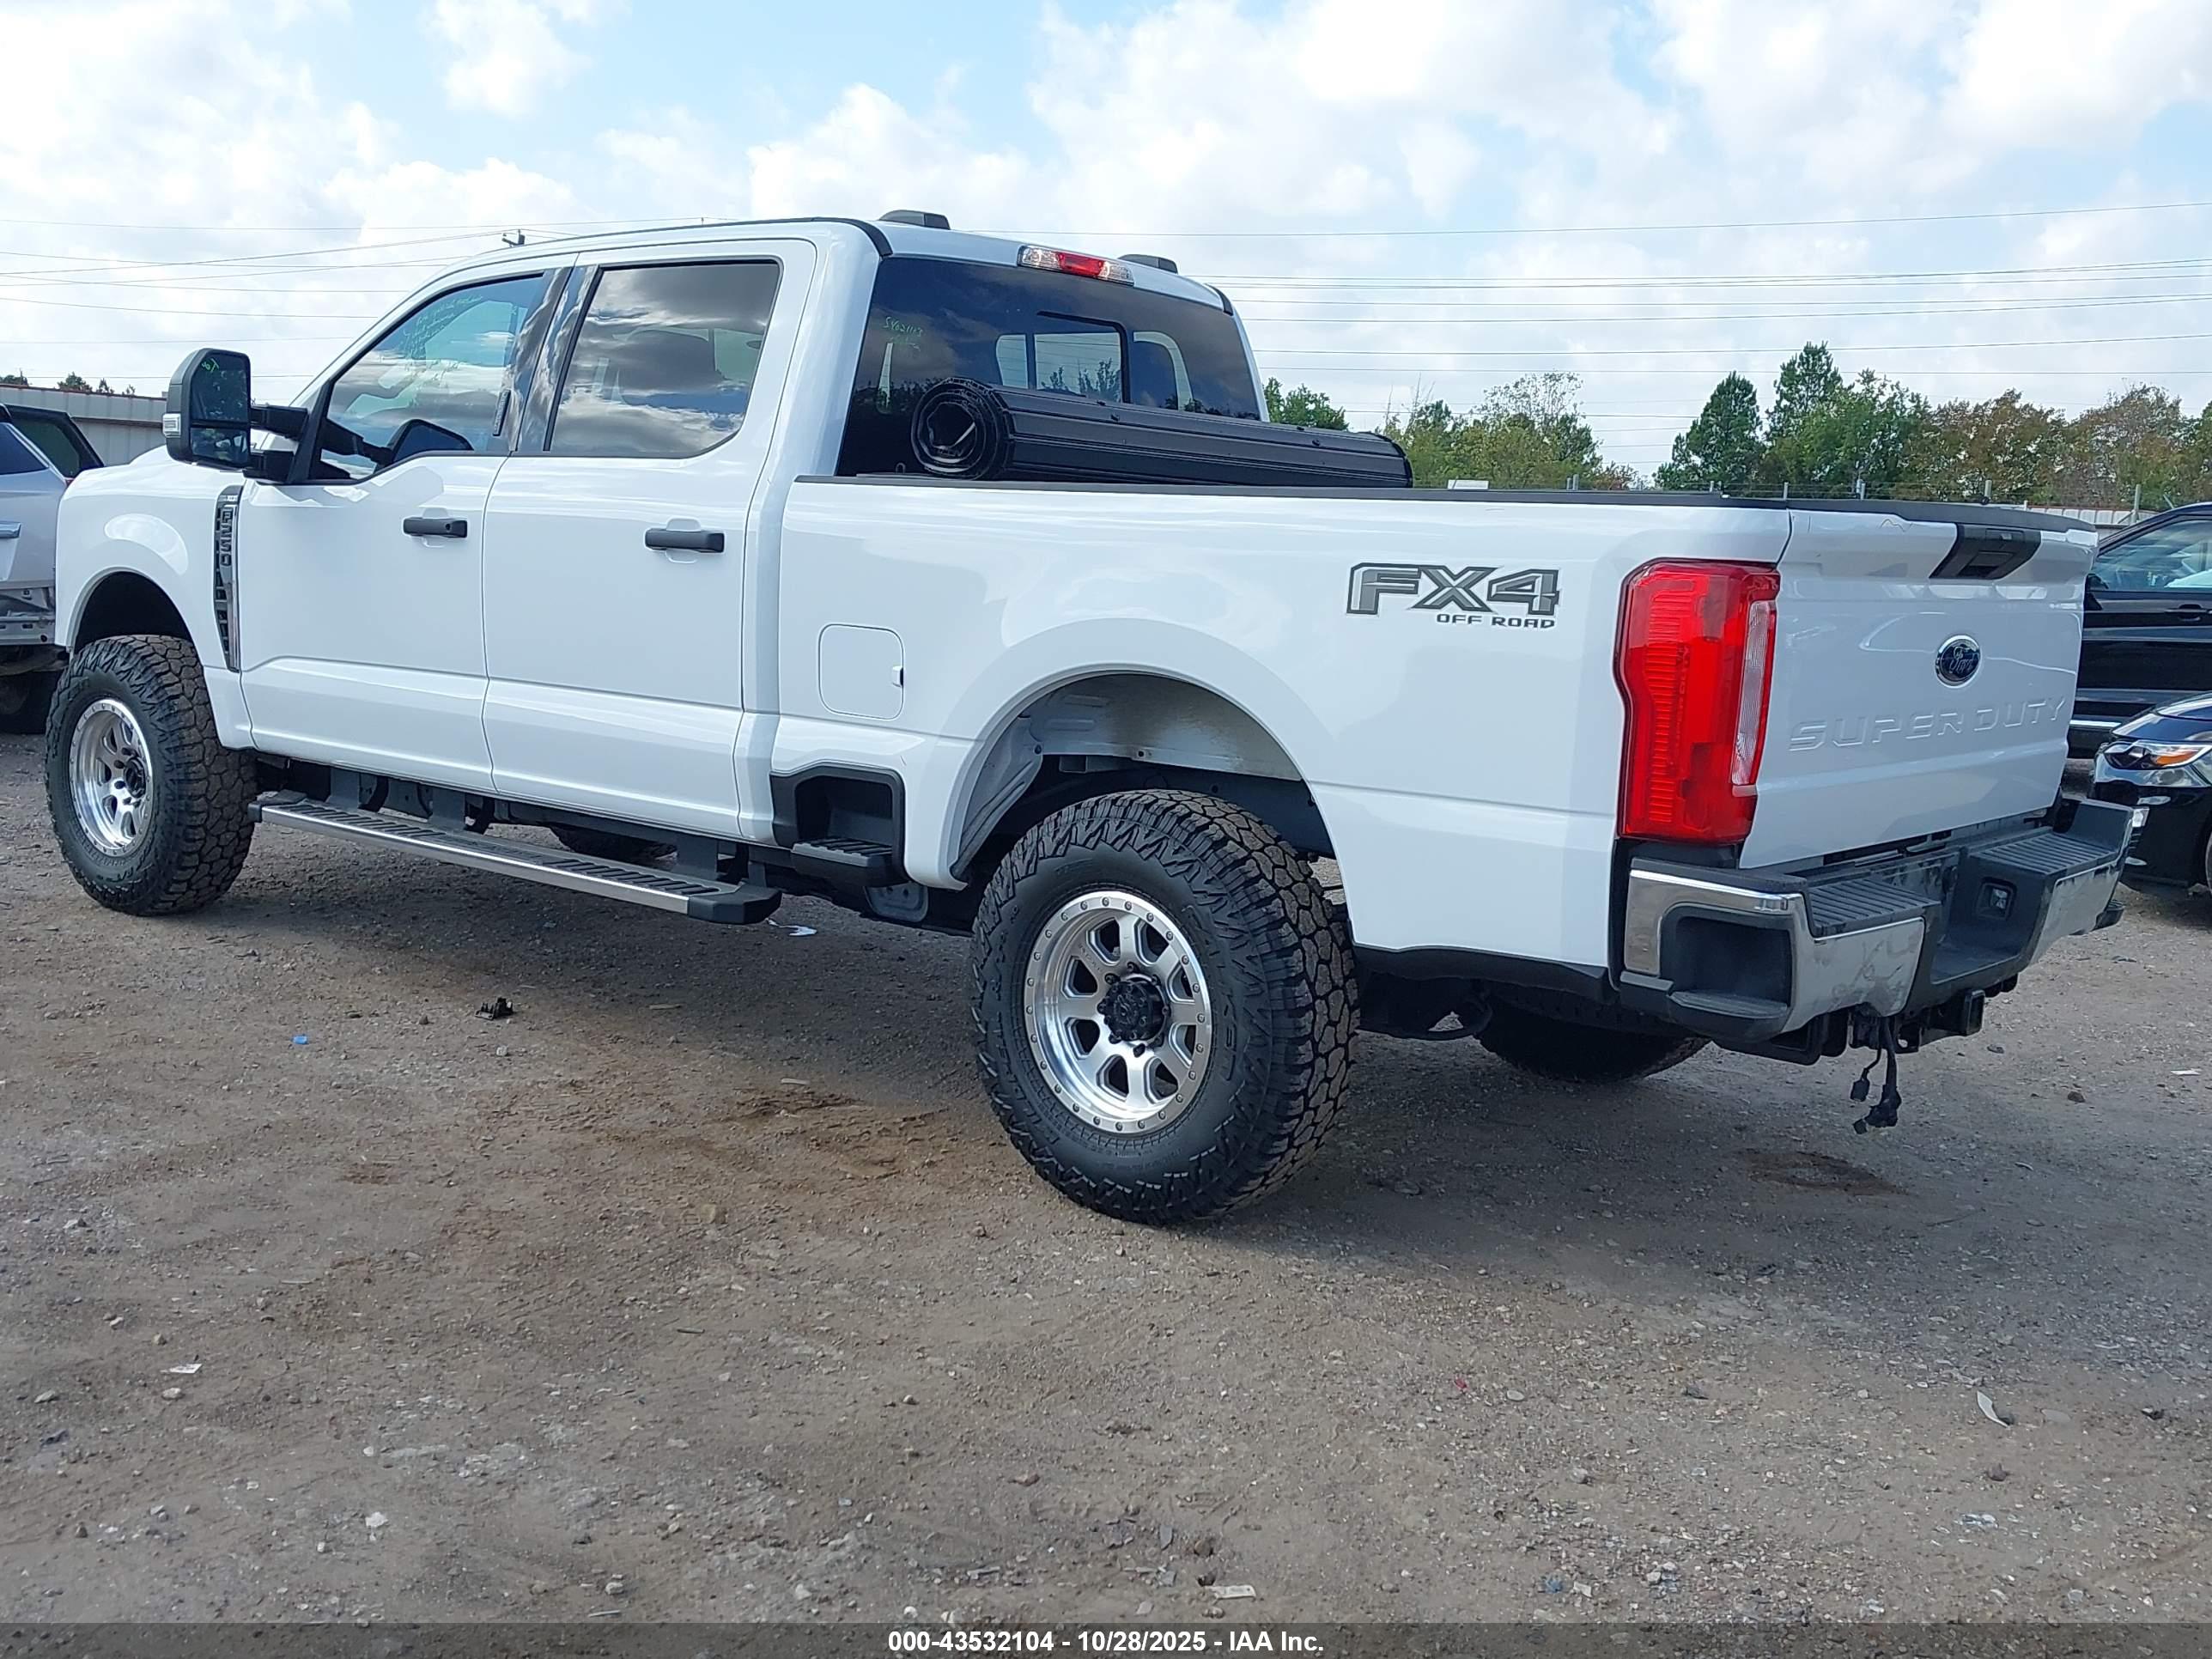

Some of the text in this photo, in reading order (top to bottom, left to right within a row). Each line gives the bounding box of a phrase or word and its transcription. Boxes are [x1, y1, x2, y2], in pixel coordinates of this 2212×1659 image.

[1346, 562, 1560, 616] FX4
[1436, 613, 1555, 629] OFF ROAD
[1789, 697, 2065, 752] SUPER DUTY
